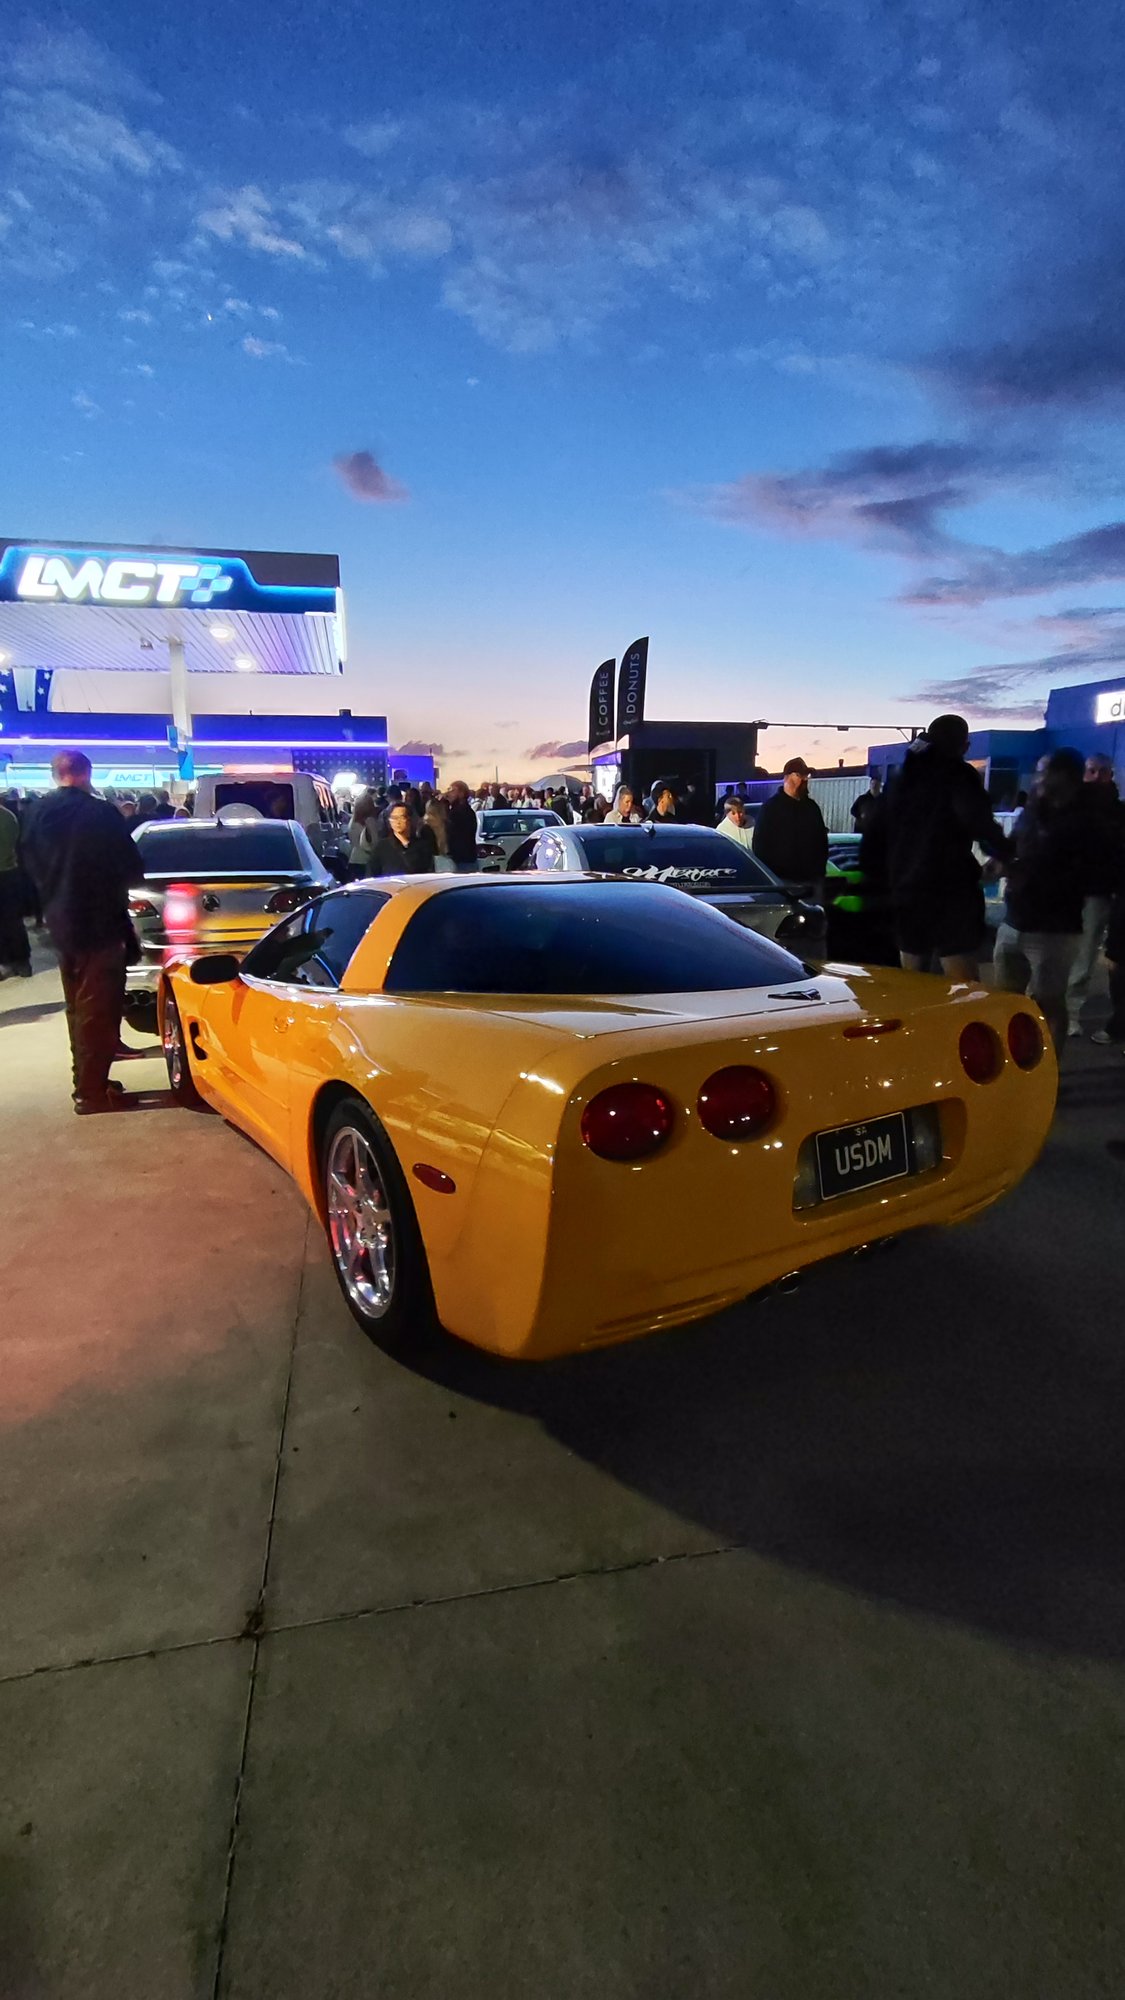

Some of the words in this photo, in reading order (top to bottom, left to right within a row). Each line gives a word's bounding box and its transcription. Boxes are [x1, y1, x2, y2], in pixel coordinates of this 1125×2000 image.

[598, 672, 609, 726] COFFEE
[626, 652, 640, 714] DONUTS
[835, 1134, 892, 1175] USDM
